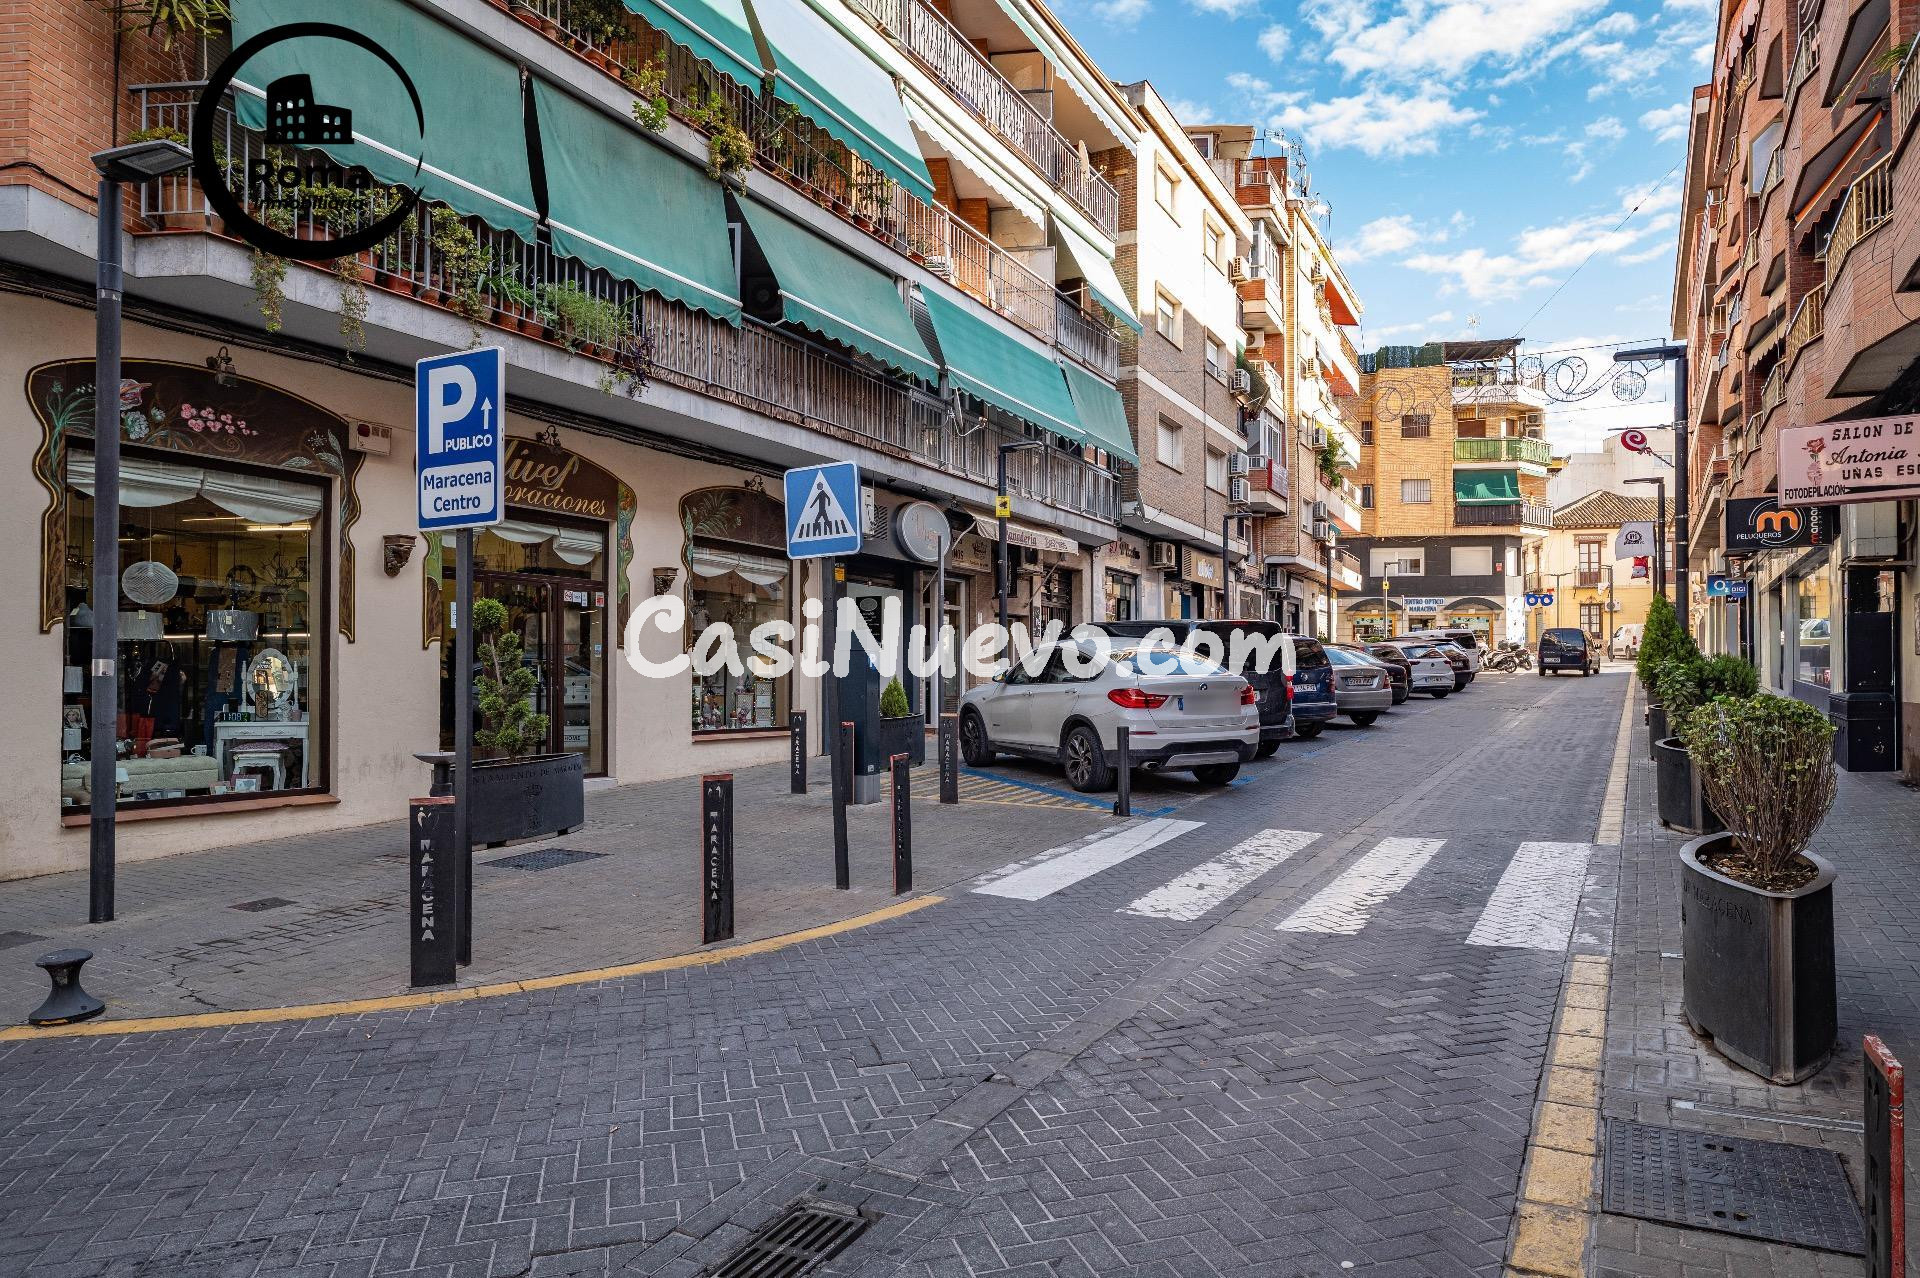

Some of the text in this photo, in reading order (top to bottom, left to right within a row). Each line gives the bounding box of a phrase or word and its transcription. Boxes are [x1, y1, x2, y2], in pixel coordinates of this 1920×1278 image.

[428, 365, 477, 454] P
[1832, 422, 1914, 441] SALON DE
[445, 434, 493, 452] PUBLICO
[1826, 446, 1908, 465] Antonia
[423, 471, 491, 490] Maracena
[433, 495, 481, 513] Centro
[505, 485, 606, 516] oraciones
[1736, 532, 1782, 540] PELUQUEROS
